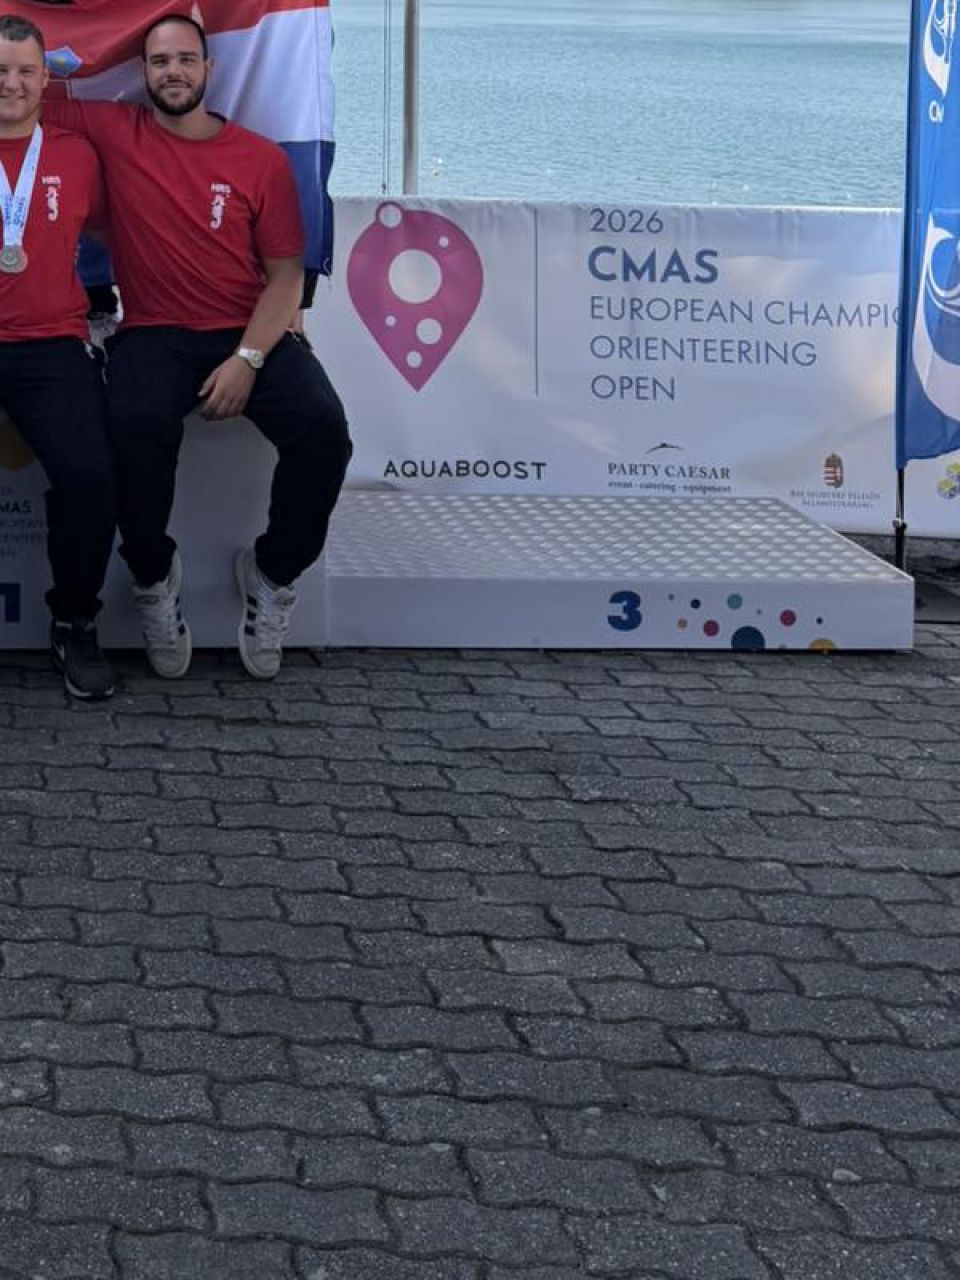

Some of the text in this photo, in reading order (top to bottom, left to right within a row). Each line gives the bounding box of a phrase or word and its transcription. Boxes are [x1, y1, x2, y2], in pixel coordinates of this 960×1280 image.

[590, 208, 664, 233] 2026
[588, 246, 719, 283] CMAS
[590, 296, 753, 323] EUROPEAN
[590, 335, 817, 366] ORIENTEERING
[591, 375, 676, 400] OPEN
[383, 460, 546, 480] AQUABOOST
[607, 463, 730, 480] PARTY CAESAR
[607, 590, 643, 631] 3
